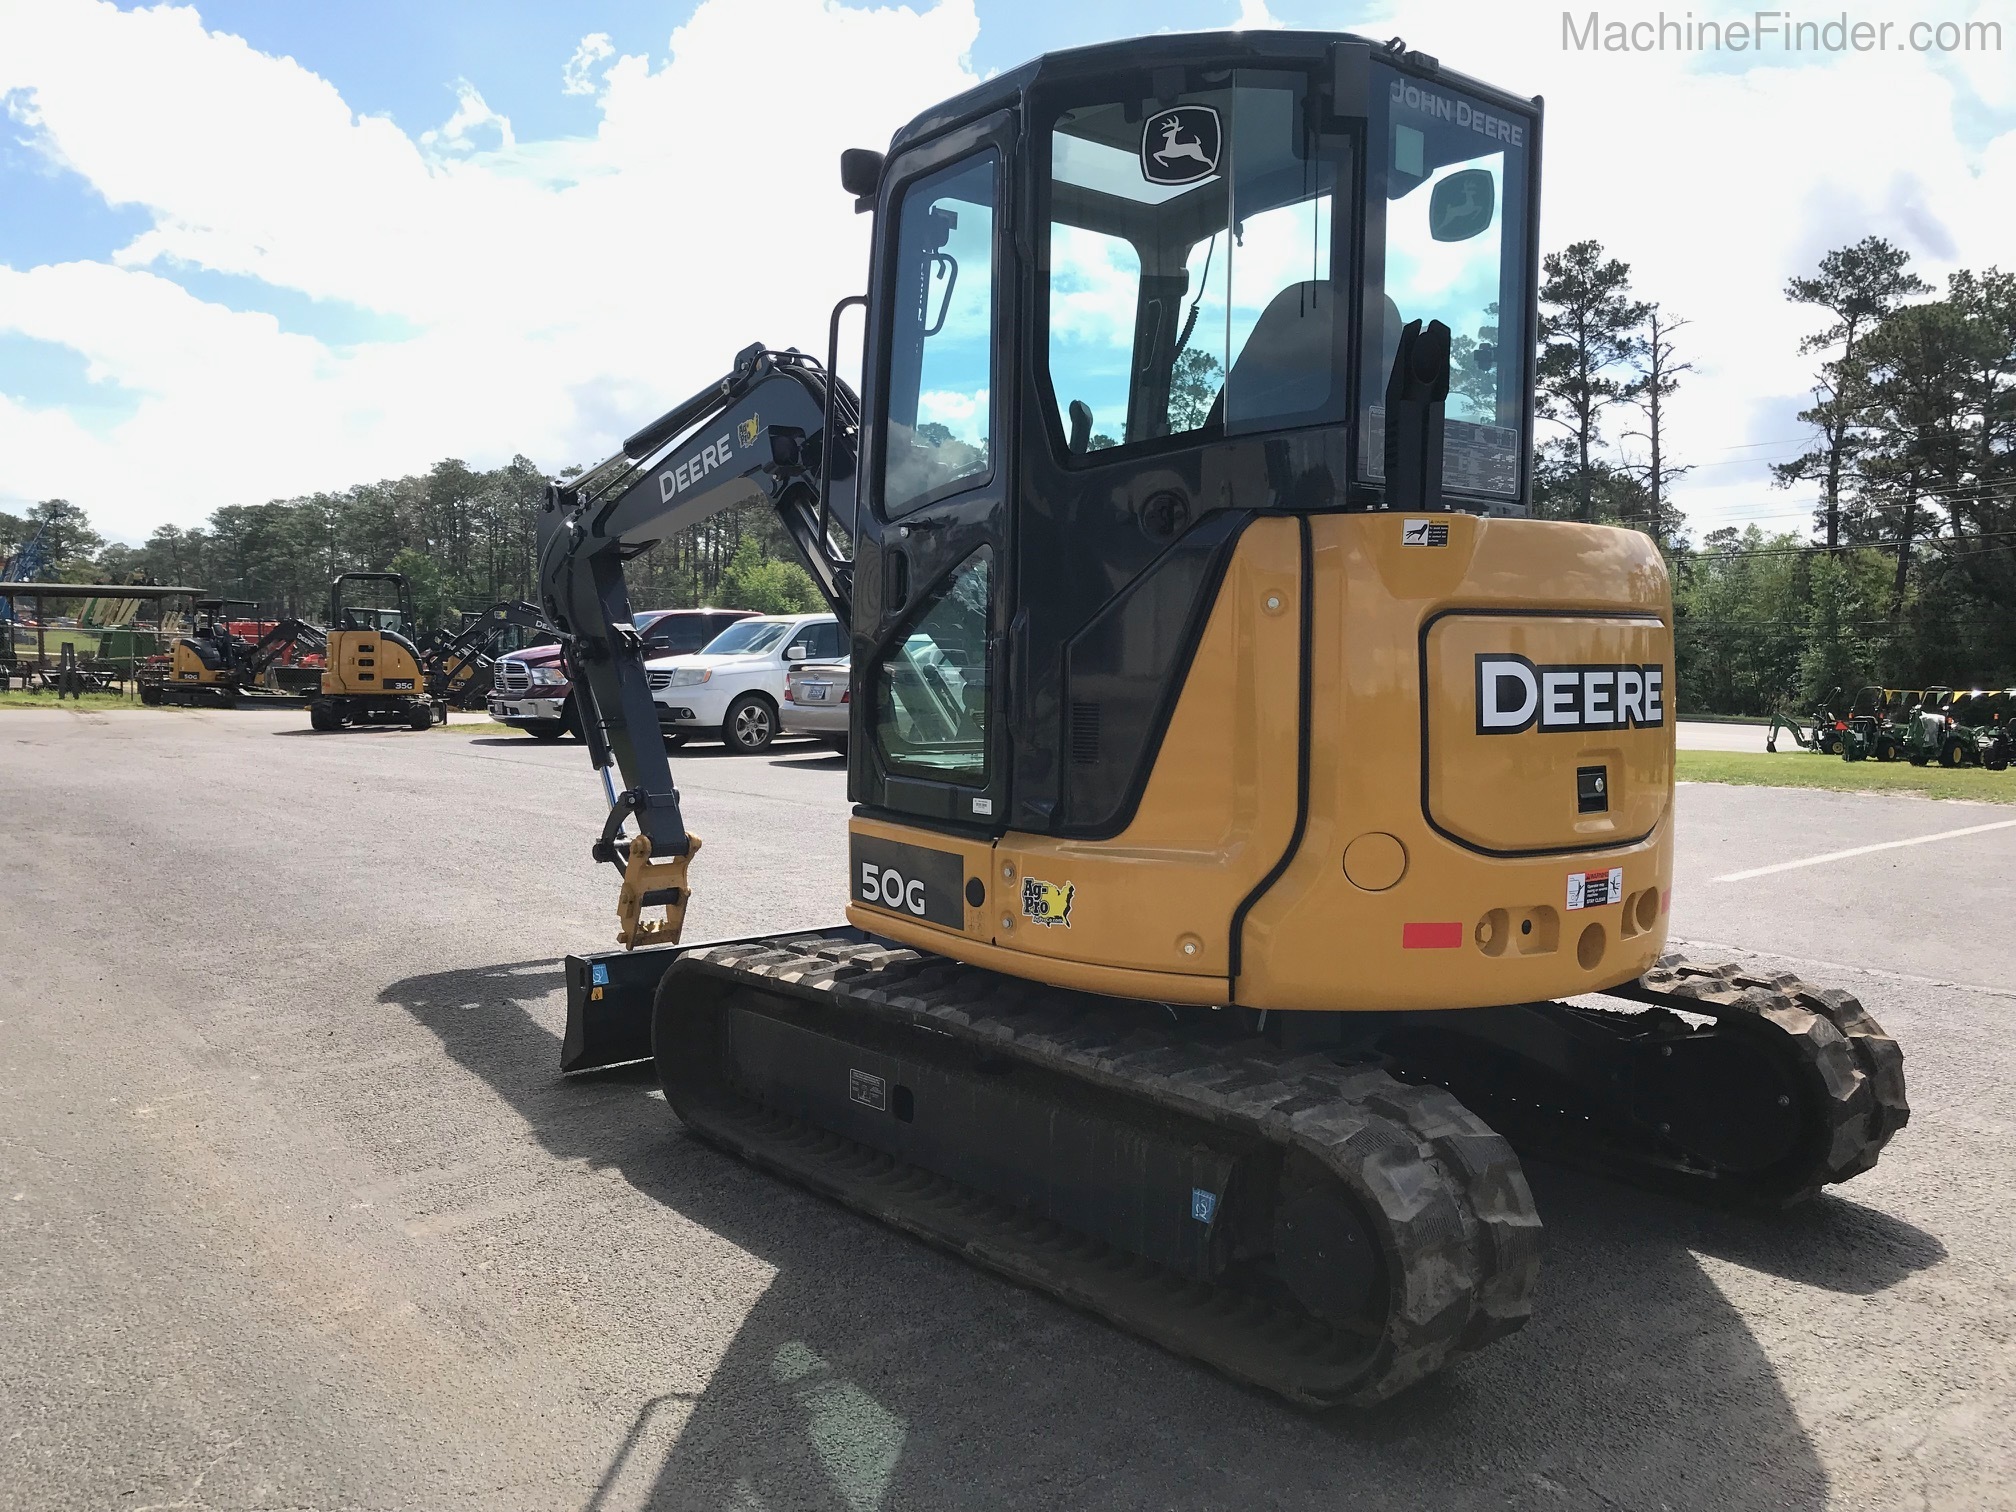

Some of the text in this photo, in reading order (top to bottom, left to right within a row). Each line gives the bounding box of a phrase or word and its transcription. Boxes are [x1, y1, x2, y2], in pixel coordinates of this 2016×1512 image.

[1391, 78, 1523, 148] JOHN DEERE
[658, 433, 733, 504] DEERE
[296, 632, 316, 648] DEERE
[395, 682, 413, 690] 35G
[1480, 660, 1664, 728] DEERE
[861, 861, 927, 916] 50G
[1024, 896, 1049, 915] Pro
